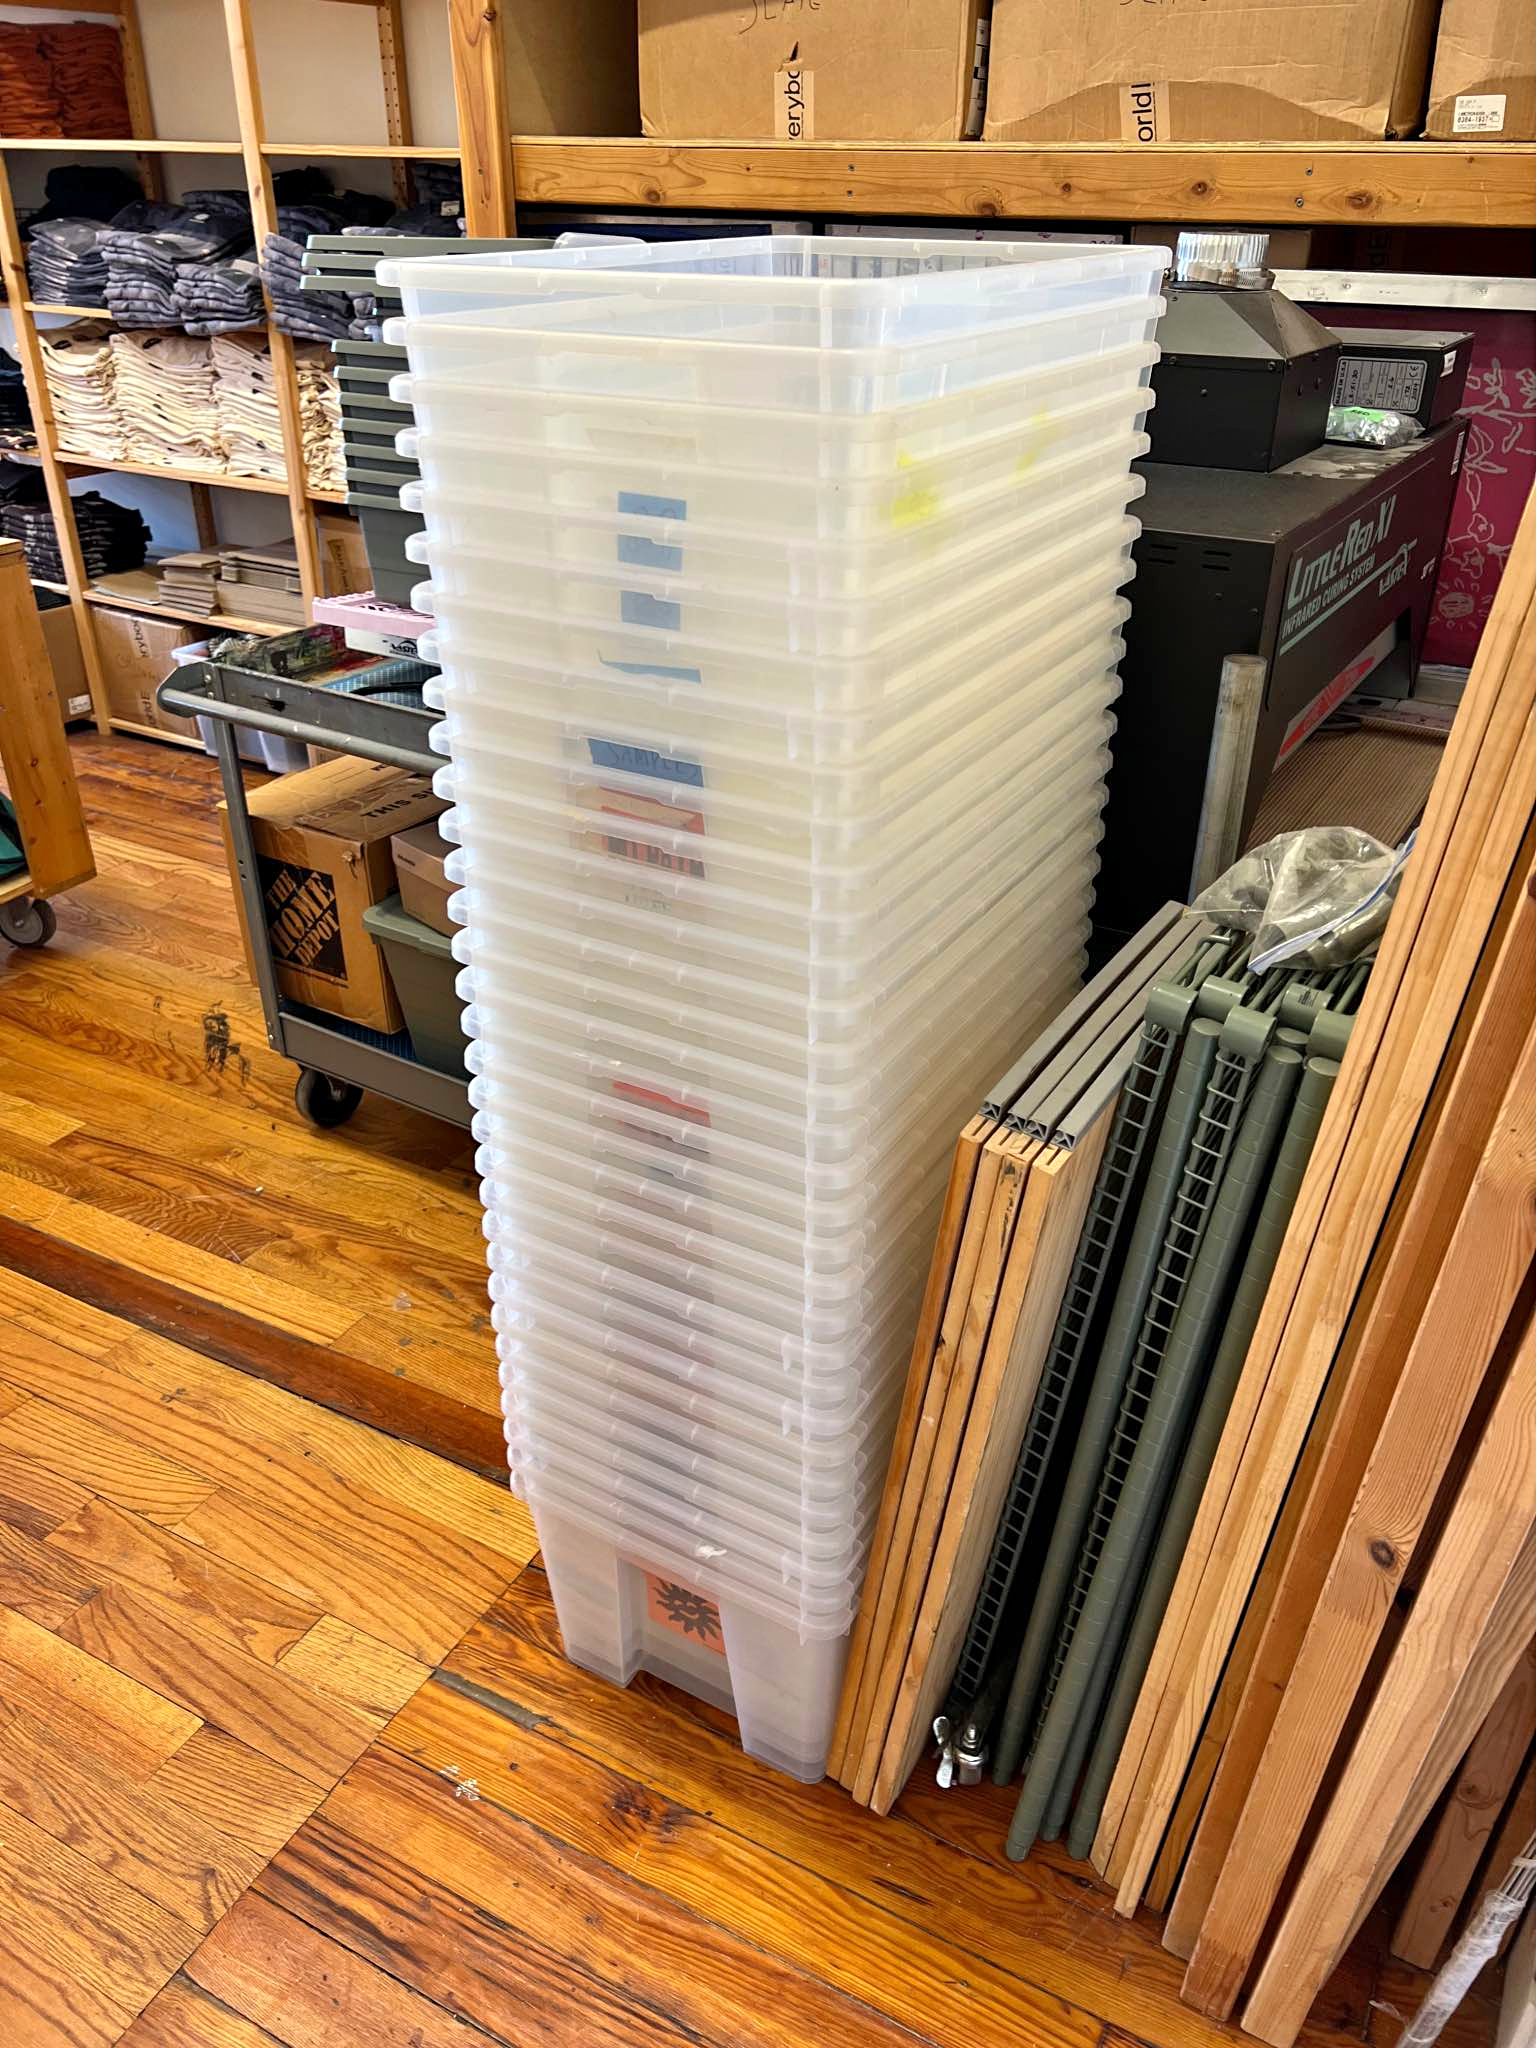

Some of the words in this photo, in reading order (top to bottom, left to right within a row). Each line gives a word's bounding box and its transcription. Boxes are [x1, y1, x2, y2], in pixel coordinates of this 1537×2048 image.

[784, 71, 805, 141] erybo
[1281, 595, 1322, 640] INFRARED
[1322, 574, 1349, 607] CURING
[1349, 552, 1376, 587] SYSTEM
[359, 799, 412, 819] THIS
[265, 868, 296, 910] THE
[270, 871, 336, 959] HOME
[294, 909, 340, 968] DEPOT
